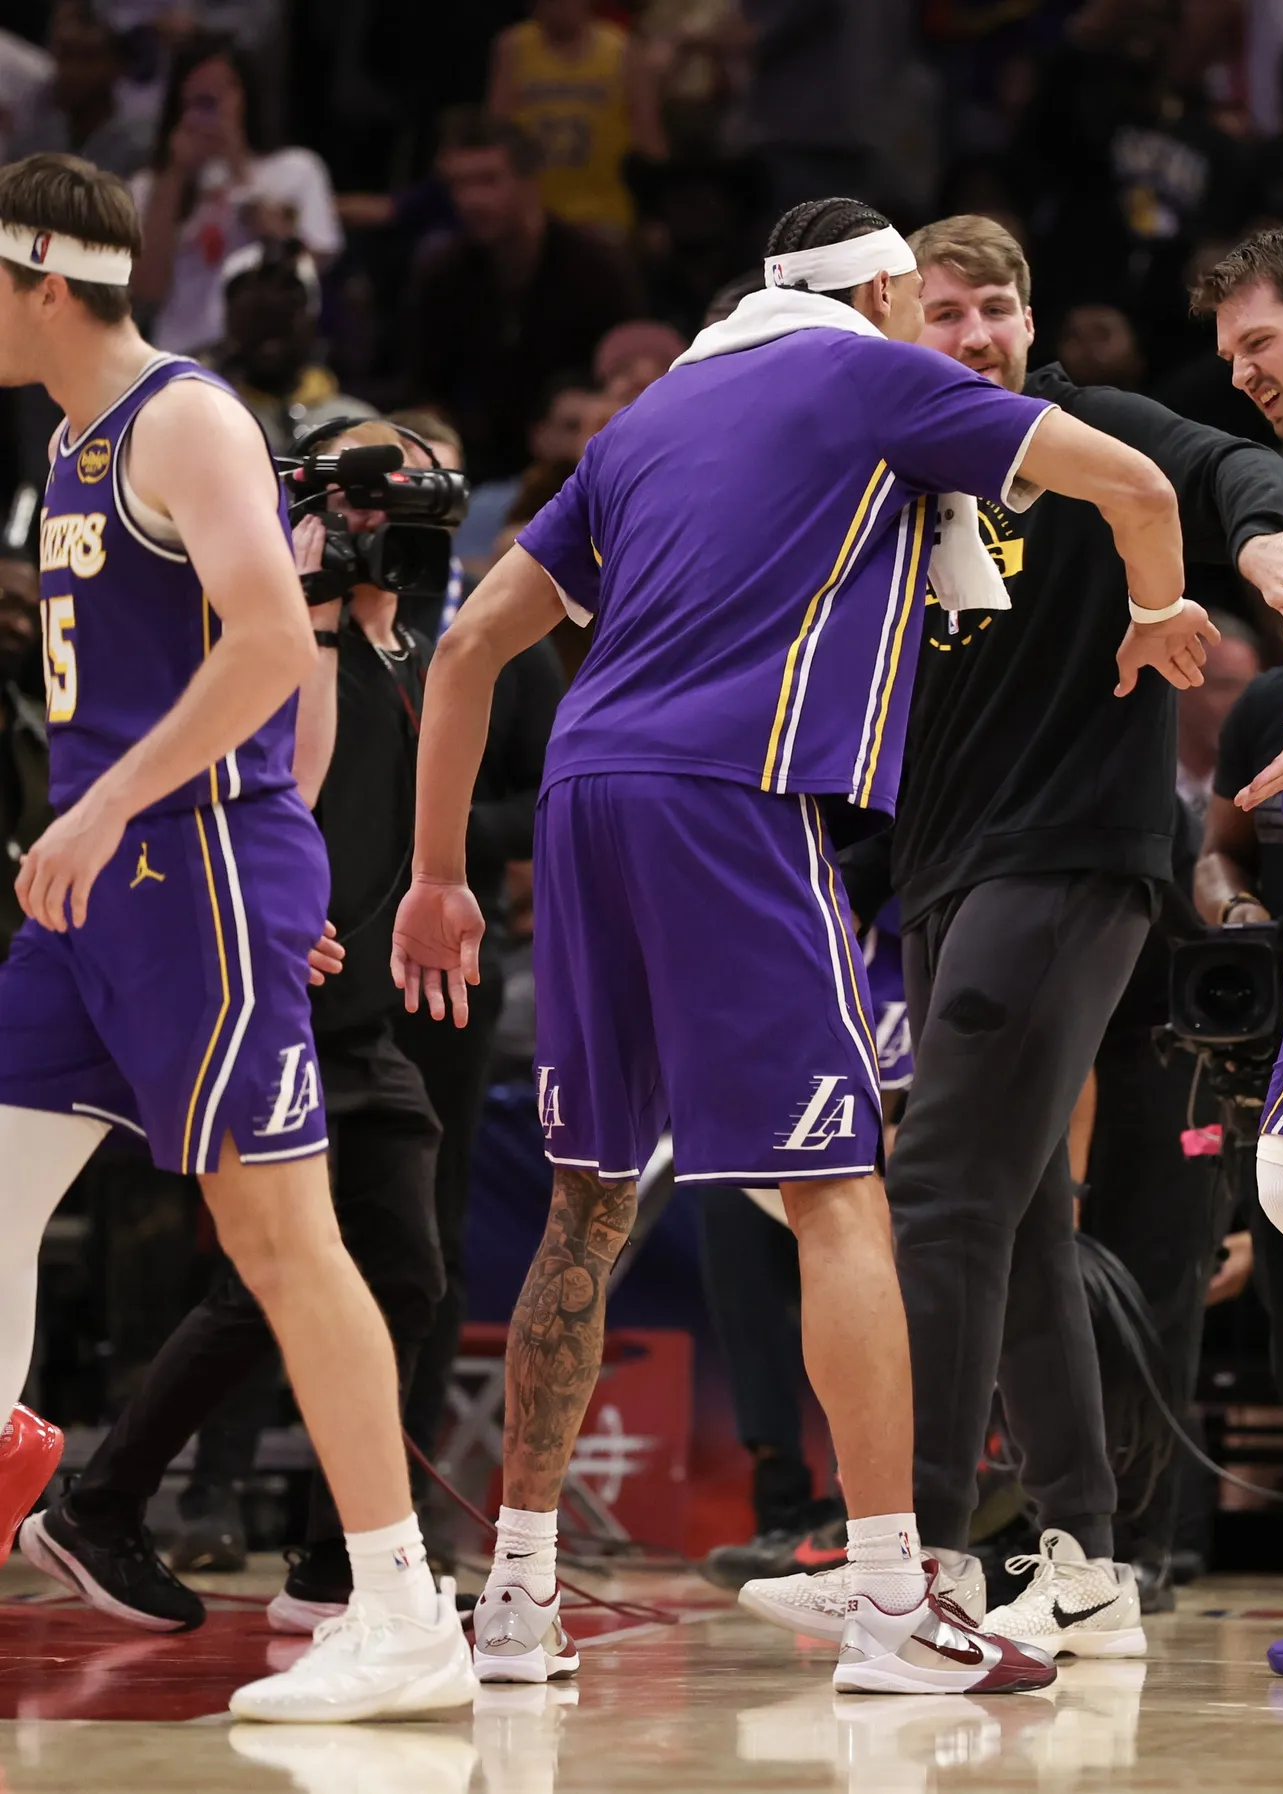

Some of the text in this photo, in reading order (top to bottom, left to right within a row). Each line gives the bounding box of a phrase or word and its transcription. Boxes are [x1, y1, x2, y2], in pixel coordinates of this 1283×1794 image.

[253, 1043, 319, 1135] LA
[537, 1066, 566, 1139] LA
[773, 1075, 856, 1150] LA
